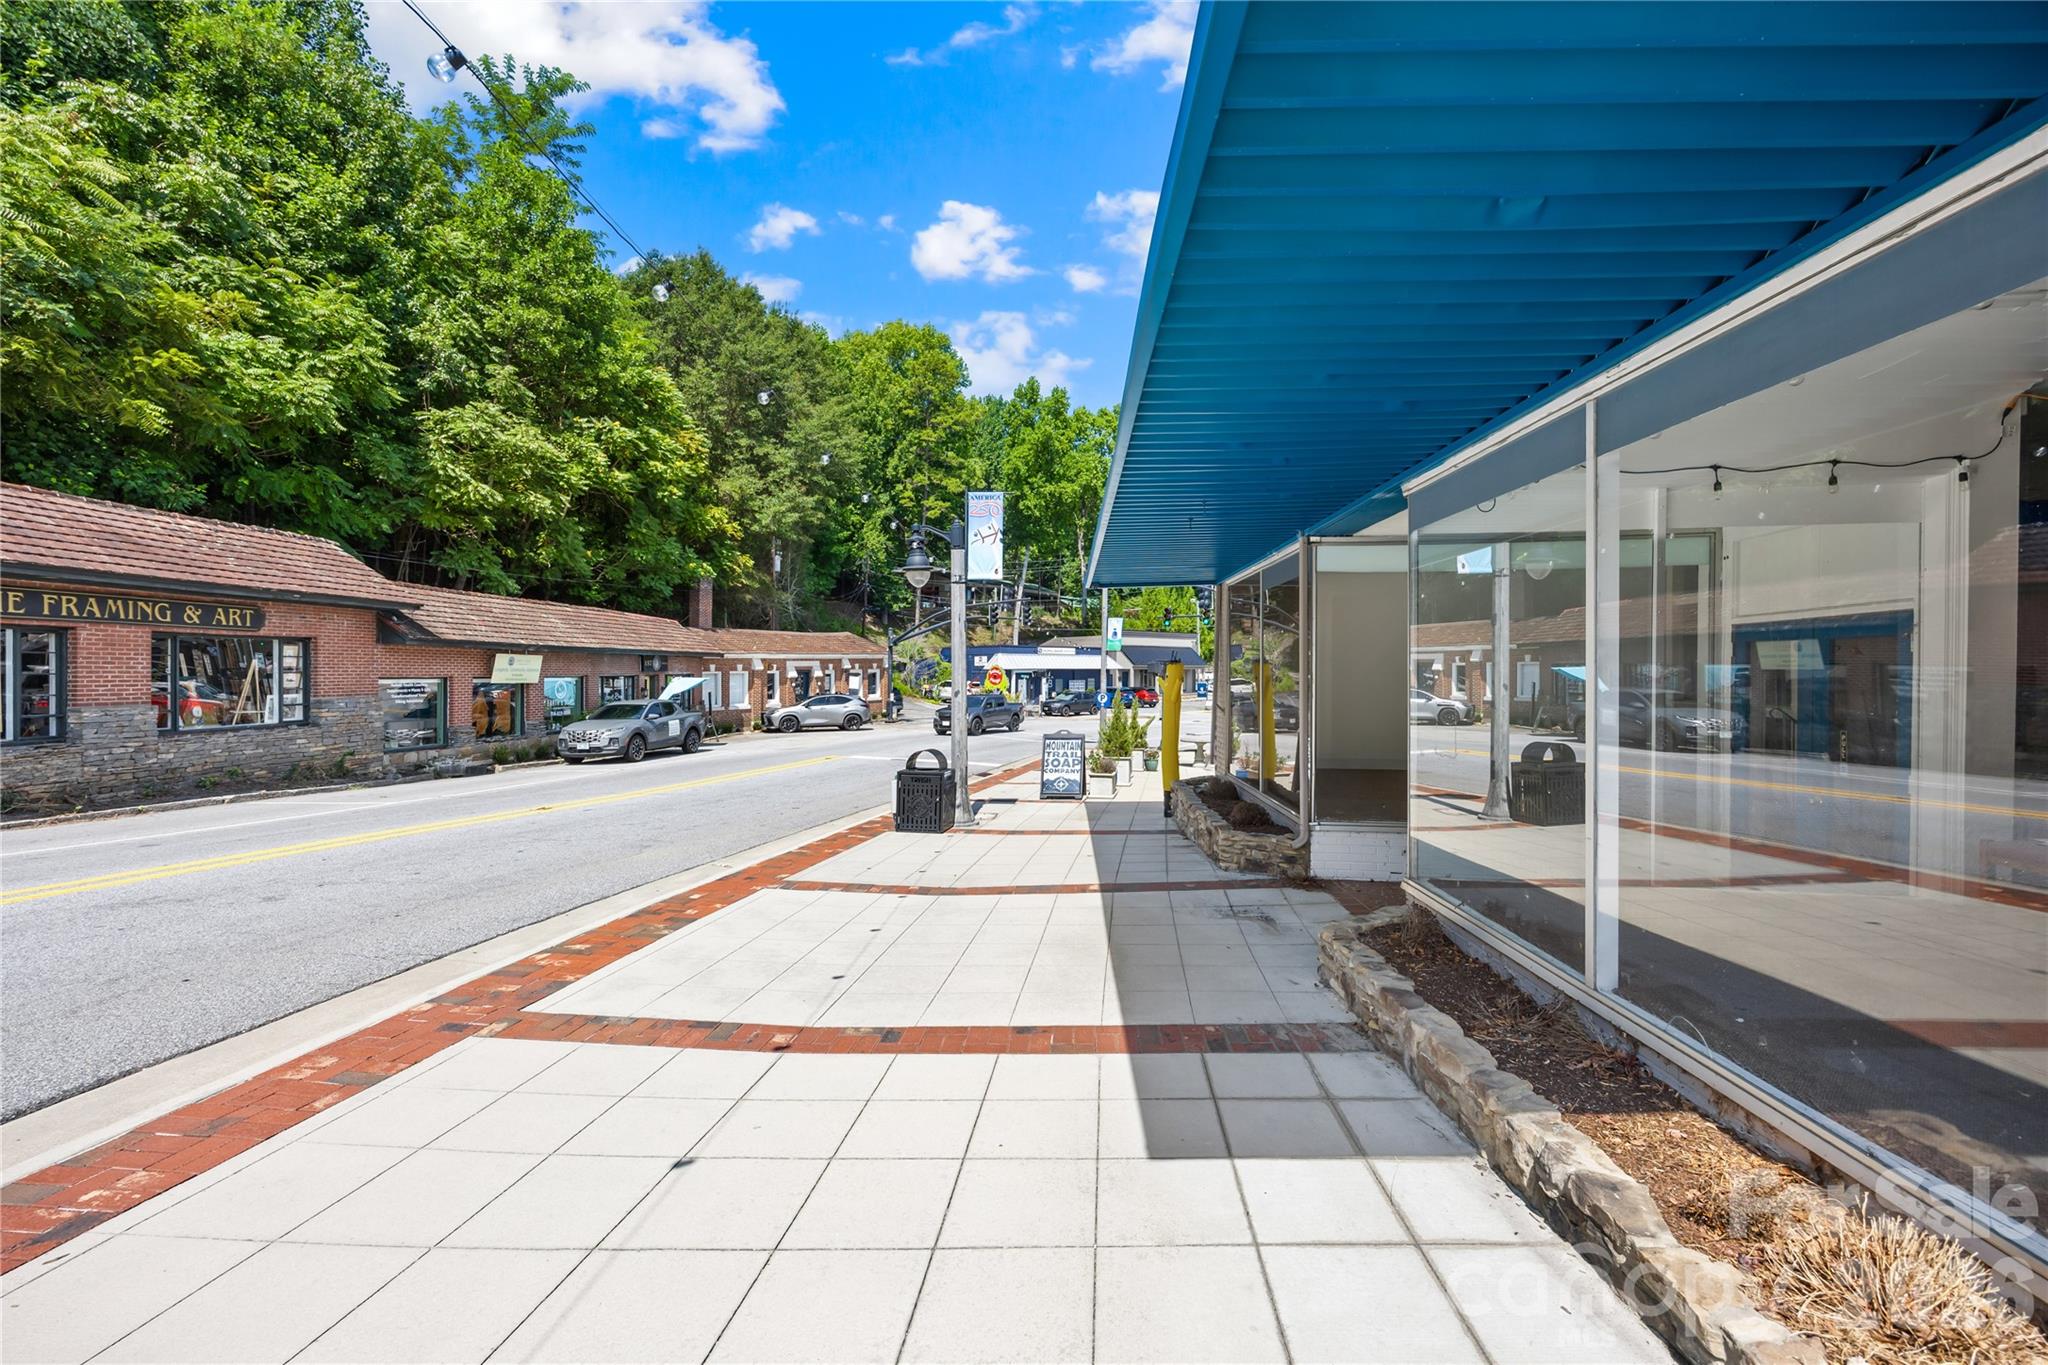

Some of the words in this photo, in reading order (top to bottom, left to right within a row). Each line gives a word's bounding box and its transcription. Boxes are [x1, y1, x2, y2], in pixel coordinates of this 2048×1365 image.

[42, 594, 172, 622] FRAMING
[184, 605, 201, 624] &
[213, 607, 254, 626] ART
[1045, 741, 1082, 751] MOUNTAIN
[1045, 759, 1081, 768] SOAP
